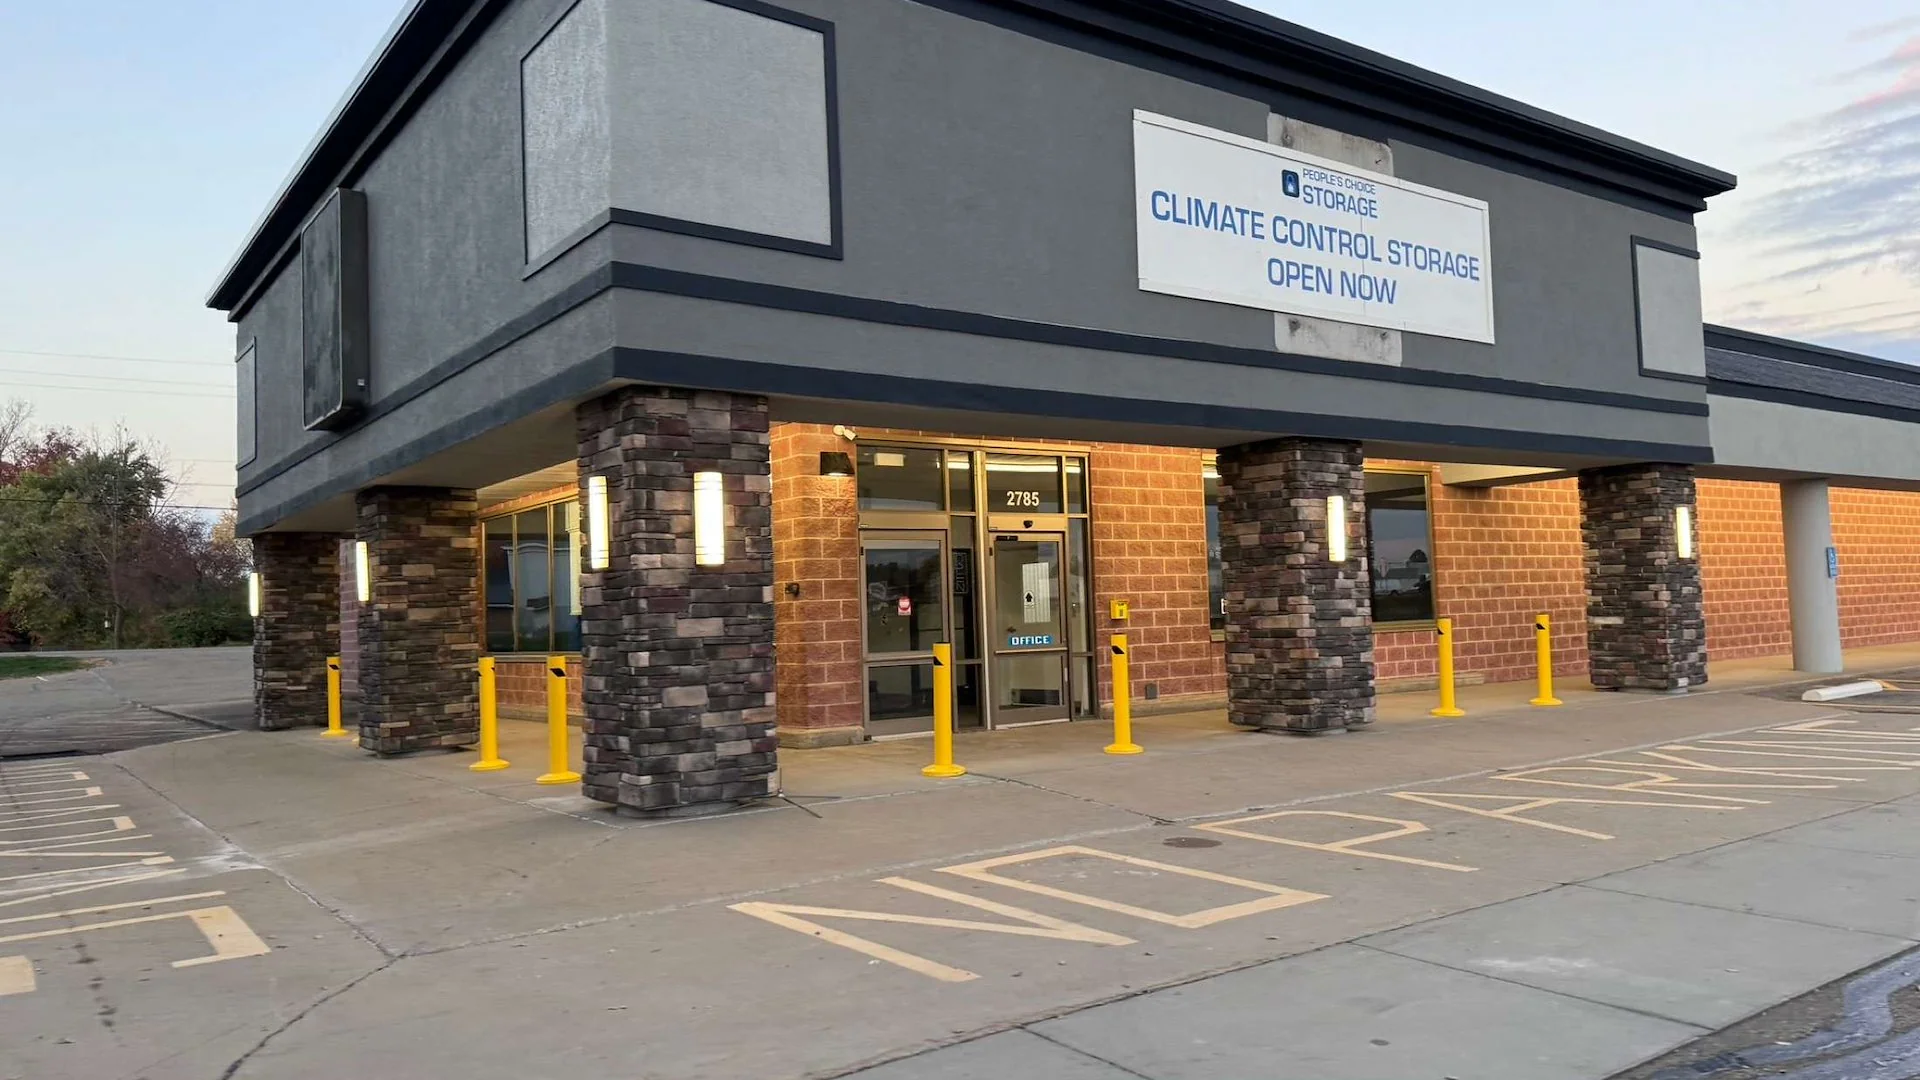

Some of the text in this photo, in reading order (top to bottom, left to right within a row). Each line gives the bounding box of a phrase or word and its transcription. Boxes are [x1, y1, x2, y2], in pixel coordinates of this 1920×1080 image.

[1302, 168, 1376, 195] PEOPLE'S CHOICE
[1303, 185, 1378, 218] STORAGE
[1151, 190, 1480, 281] CLIMATE CONTROL STORAGE
[1267, 258, 1397, 304] OPEN NOW
[1006, 490, 1040, 507] 2785
[1011, 635, 1050, 646] OFFICE
[726, 845, 1332, 982] NO
